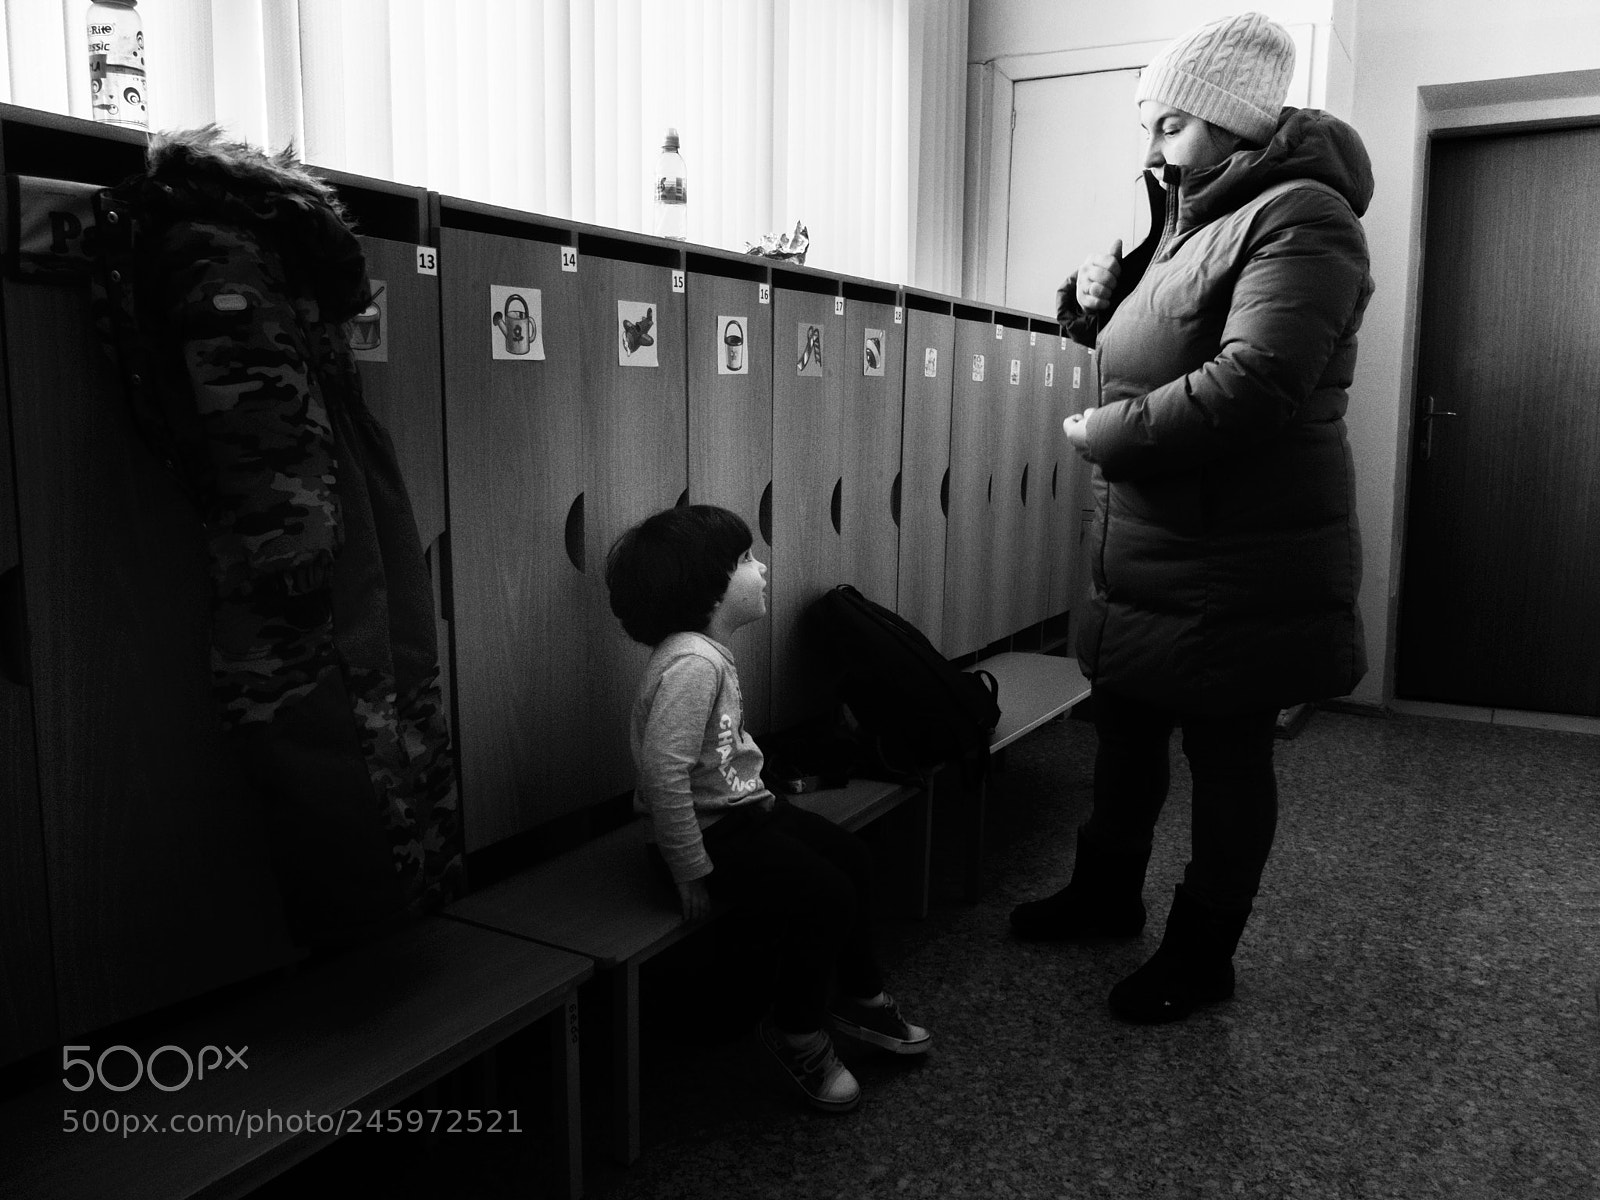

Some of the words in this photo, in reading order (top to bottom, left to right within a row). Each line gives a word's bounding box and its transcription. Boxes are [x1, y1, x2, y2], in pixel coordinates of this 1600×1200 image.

[90, 25, 112, 35] Rite
[419, 253, 435, 270] 13
[563, 253, 576, 267] 14
[673, 276, 684, 288] 15
[760, 289, 769, 300] 16
[836, 301, 844, 311] 17
